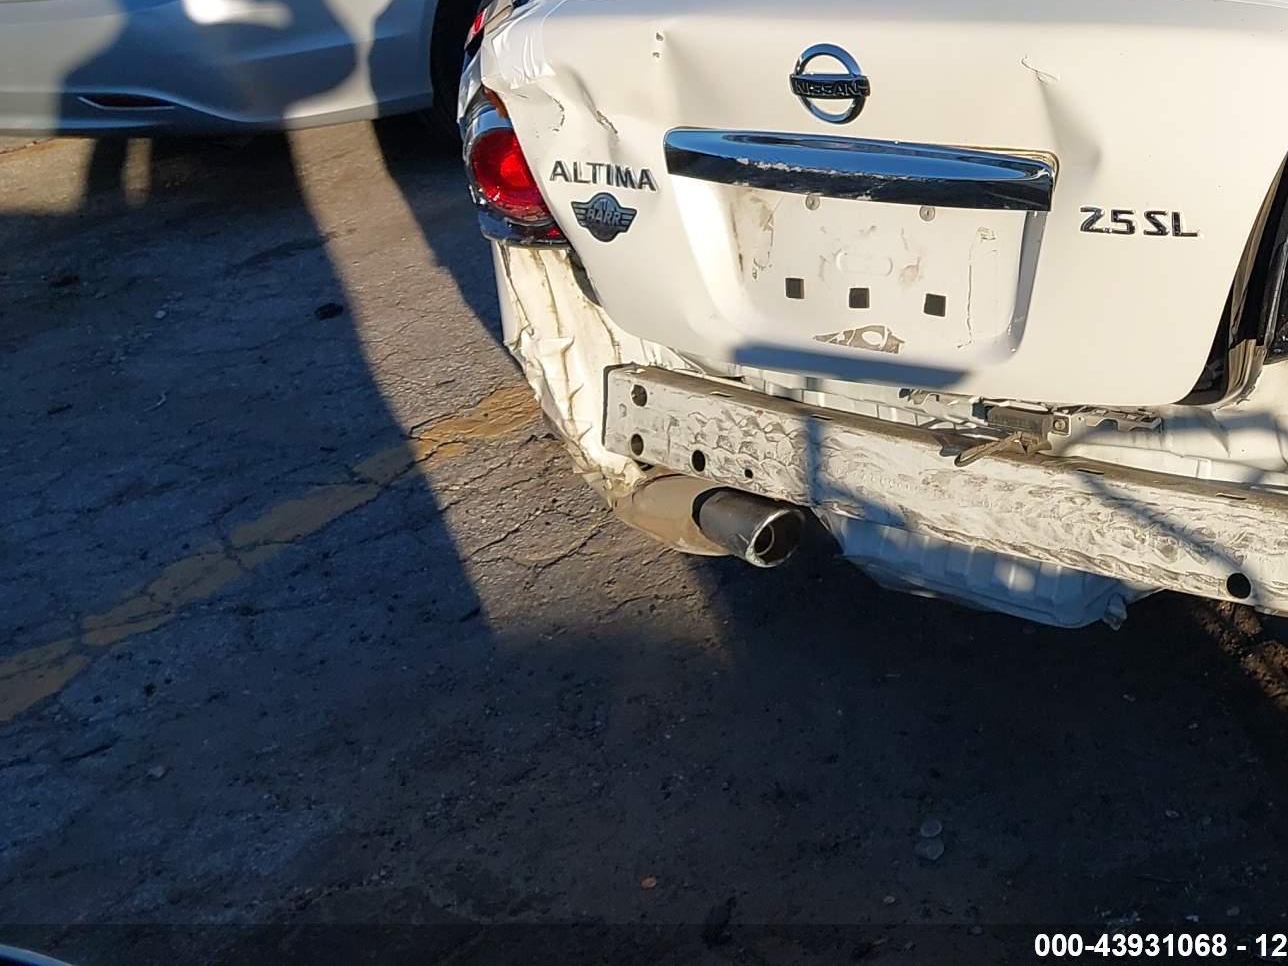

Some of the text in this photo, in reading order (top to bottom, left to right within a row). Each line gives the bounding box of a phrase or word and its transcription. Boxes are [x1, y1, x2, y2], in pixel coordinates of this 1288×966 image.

[795, 80, 860, 96] NISSAN
[549, 160, 658, 192] ALTIMA
[1143, 211, 1199, 237] SL
